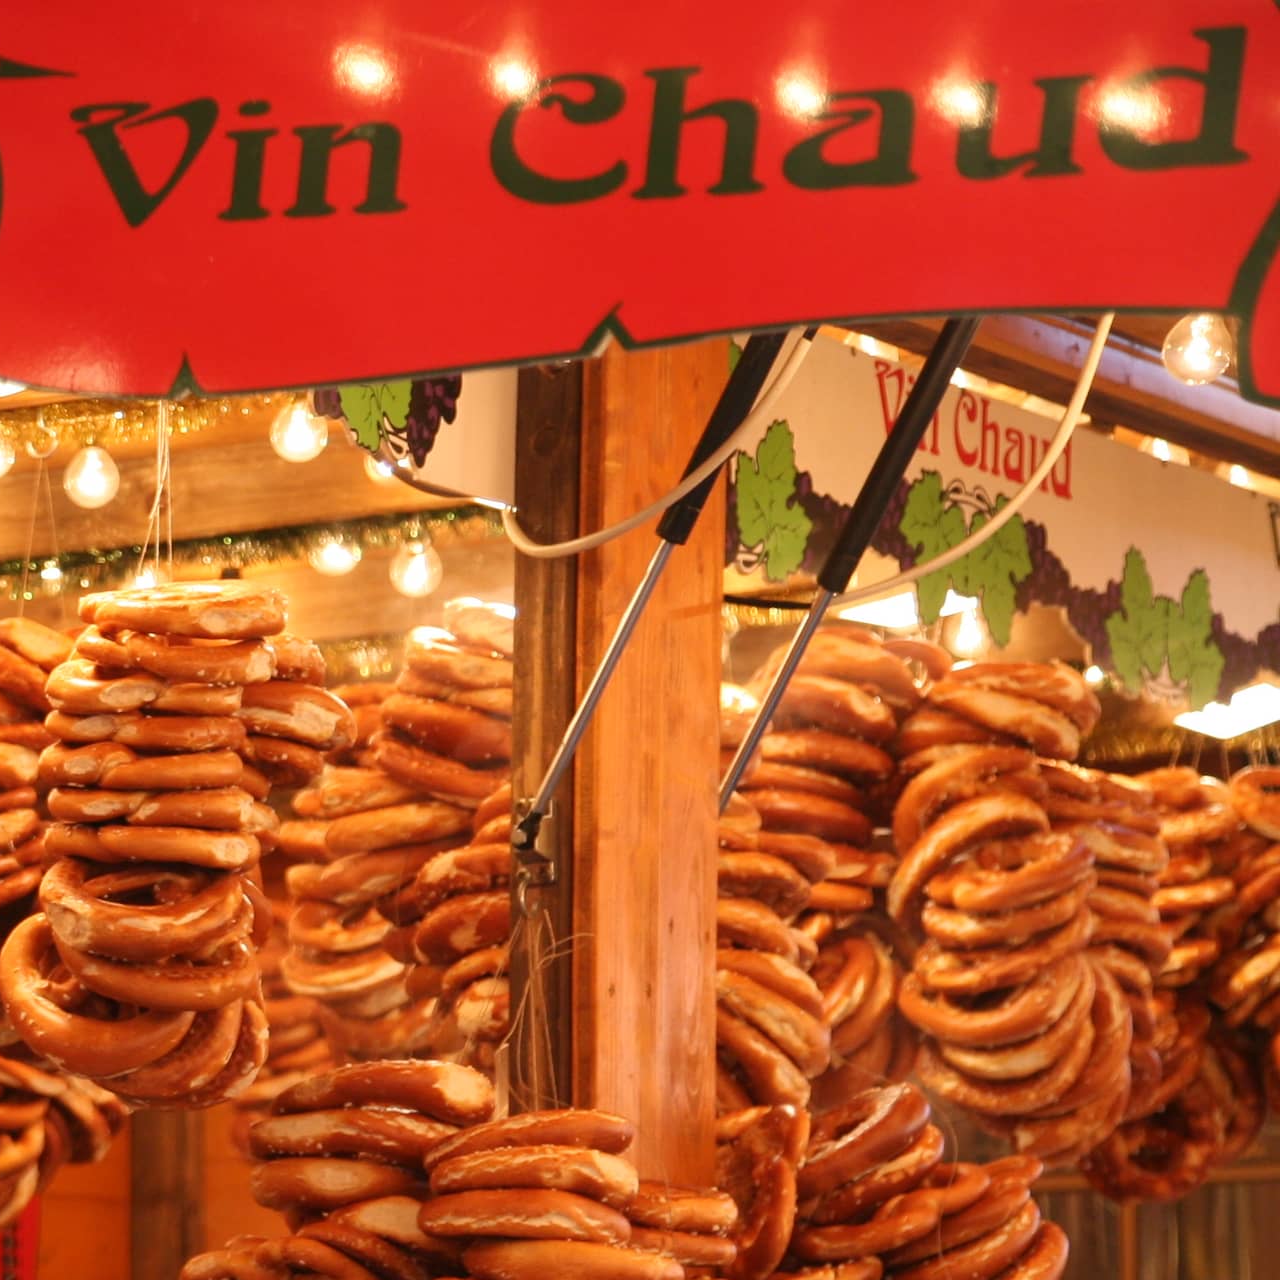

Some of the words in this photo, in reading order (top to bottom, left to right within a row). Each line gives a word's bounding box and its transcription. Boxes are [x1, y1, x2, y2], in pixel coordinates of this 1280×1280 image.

[70, 97, 408, 228] Vin
[490, 26, 1251, 206] Chaud
[874, 360, 941, 456] Vn
[954, 389, 1073, 500] Chaud
